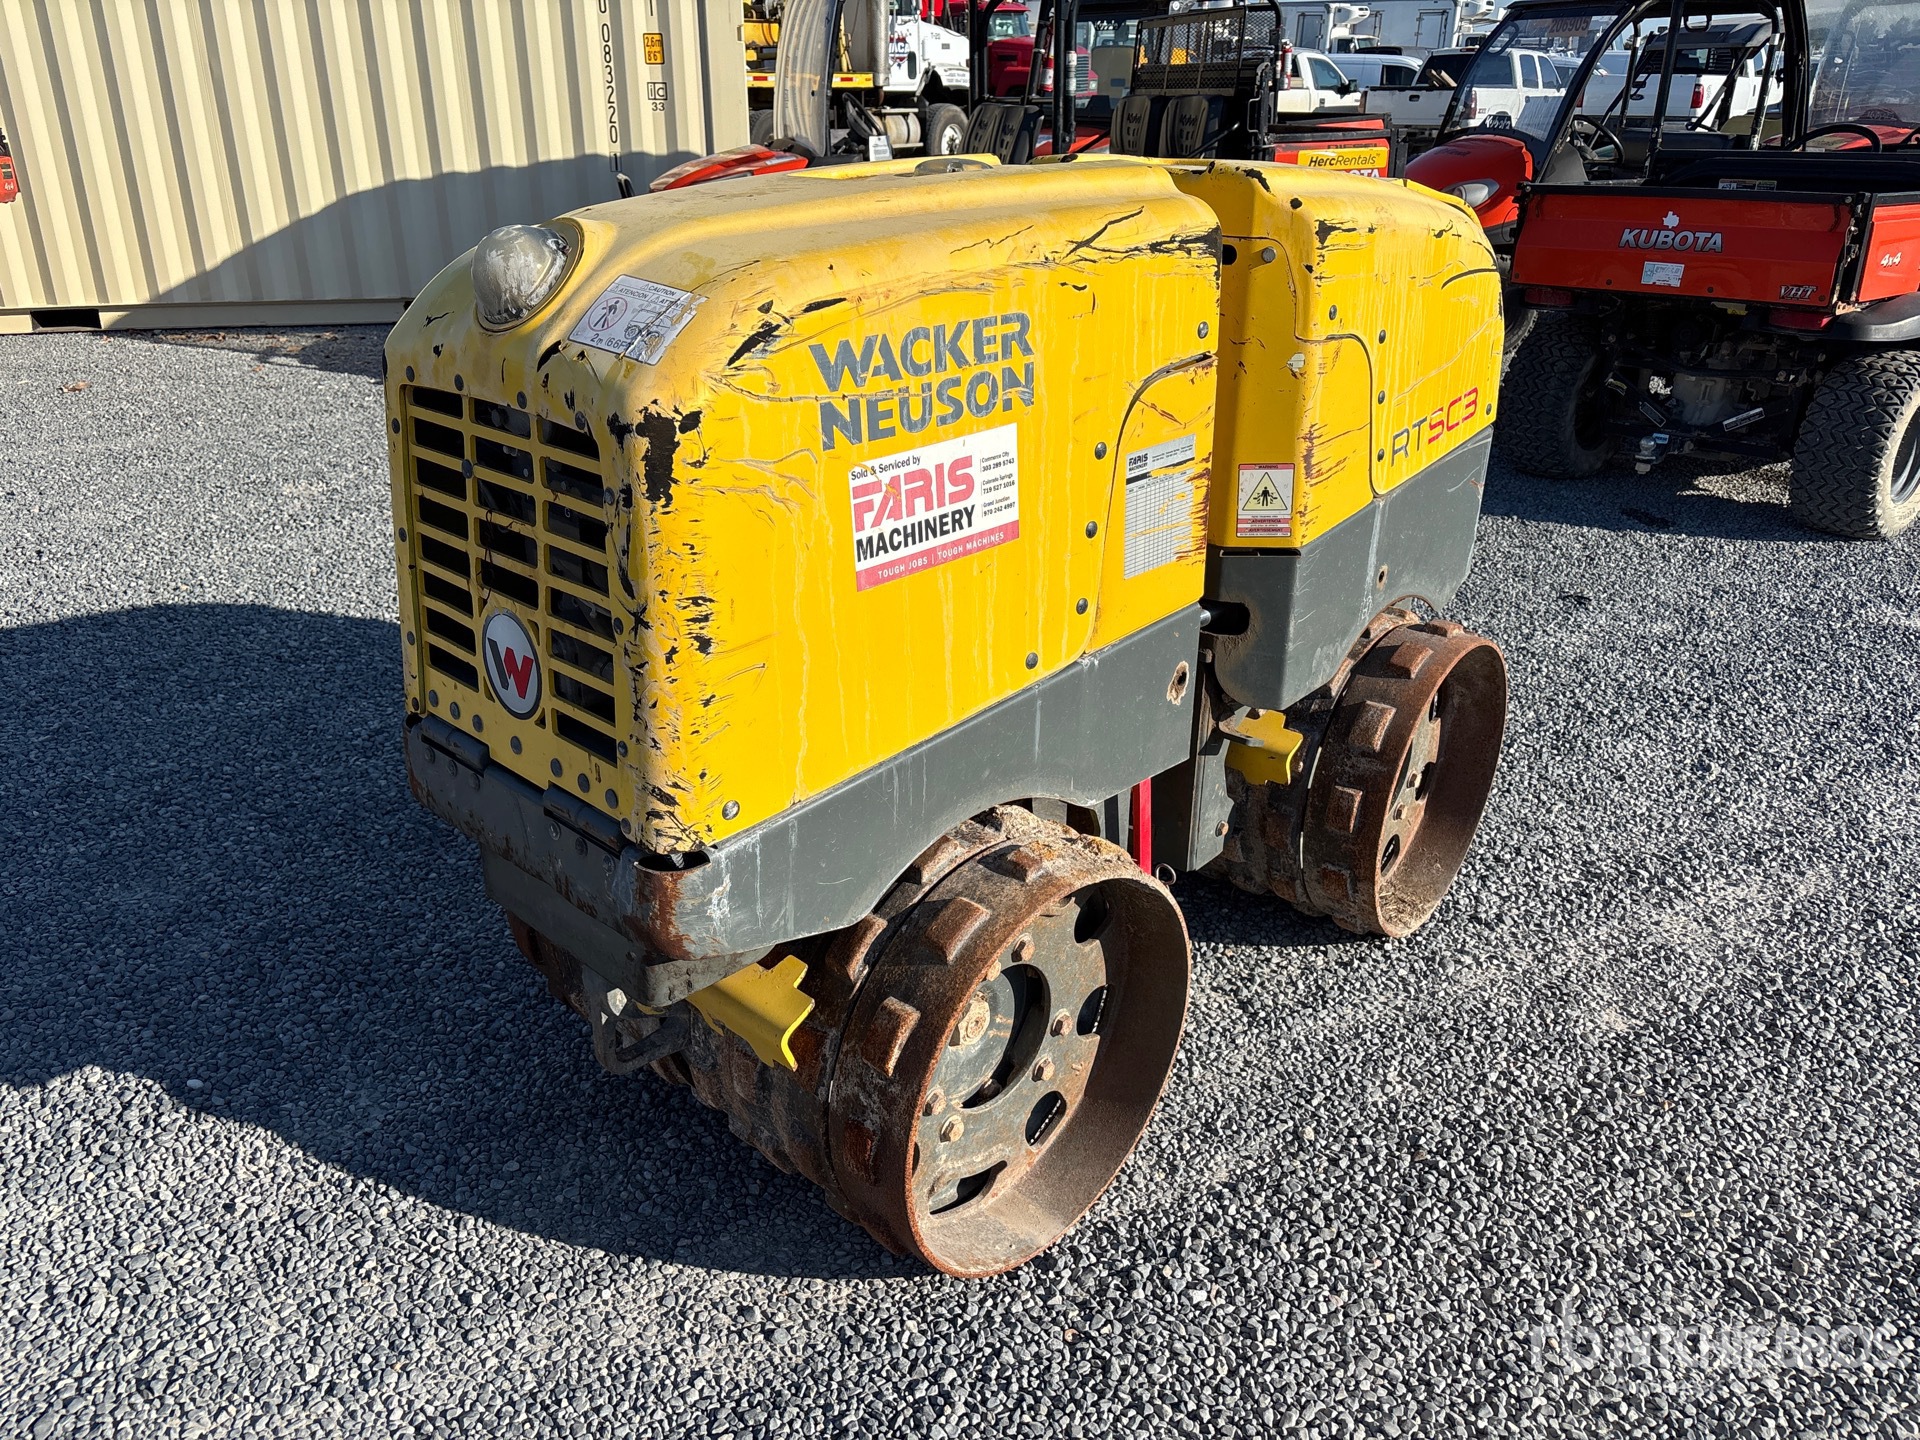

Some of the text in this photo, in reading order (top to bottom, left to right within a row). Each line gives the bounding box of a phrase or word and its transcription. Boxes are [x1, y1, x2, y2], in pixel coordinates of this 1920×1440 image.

[651, 102, 665, 112] 33
[1619, 228, 1723, 253] KUBOTA
[1880, 252, 1902, 268] 4x4
[649, 285, 677, 297] CAUTION
[808, 312, 1034, 393] WACKER
[820, 362, 1034, 452] NEUSON
[982, 453, 1001, 463] Commerce
[1128, 453, 1148, 467] FARIS
[851, 455, 922, 481] Sold & Serviced by
[999, 472, 1013, 482] Springs
[852, 455, 975, 533] FARIS
[983, 479, 1015, 495] 719 527 1016
[983, 495, 1010, 508] Grand Junction
[983, 508, 993, 517] 970
[855, 504, 976, 562] MACHINERY
[878, 531, 1004, 579] TOUGH JOBS TOUGH MACHINES
